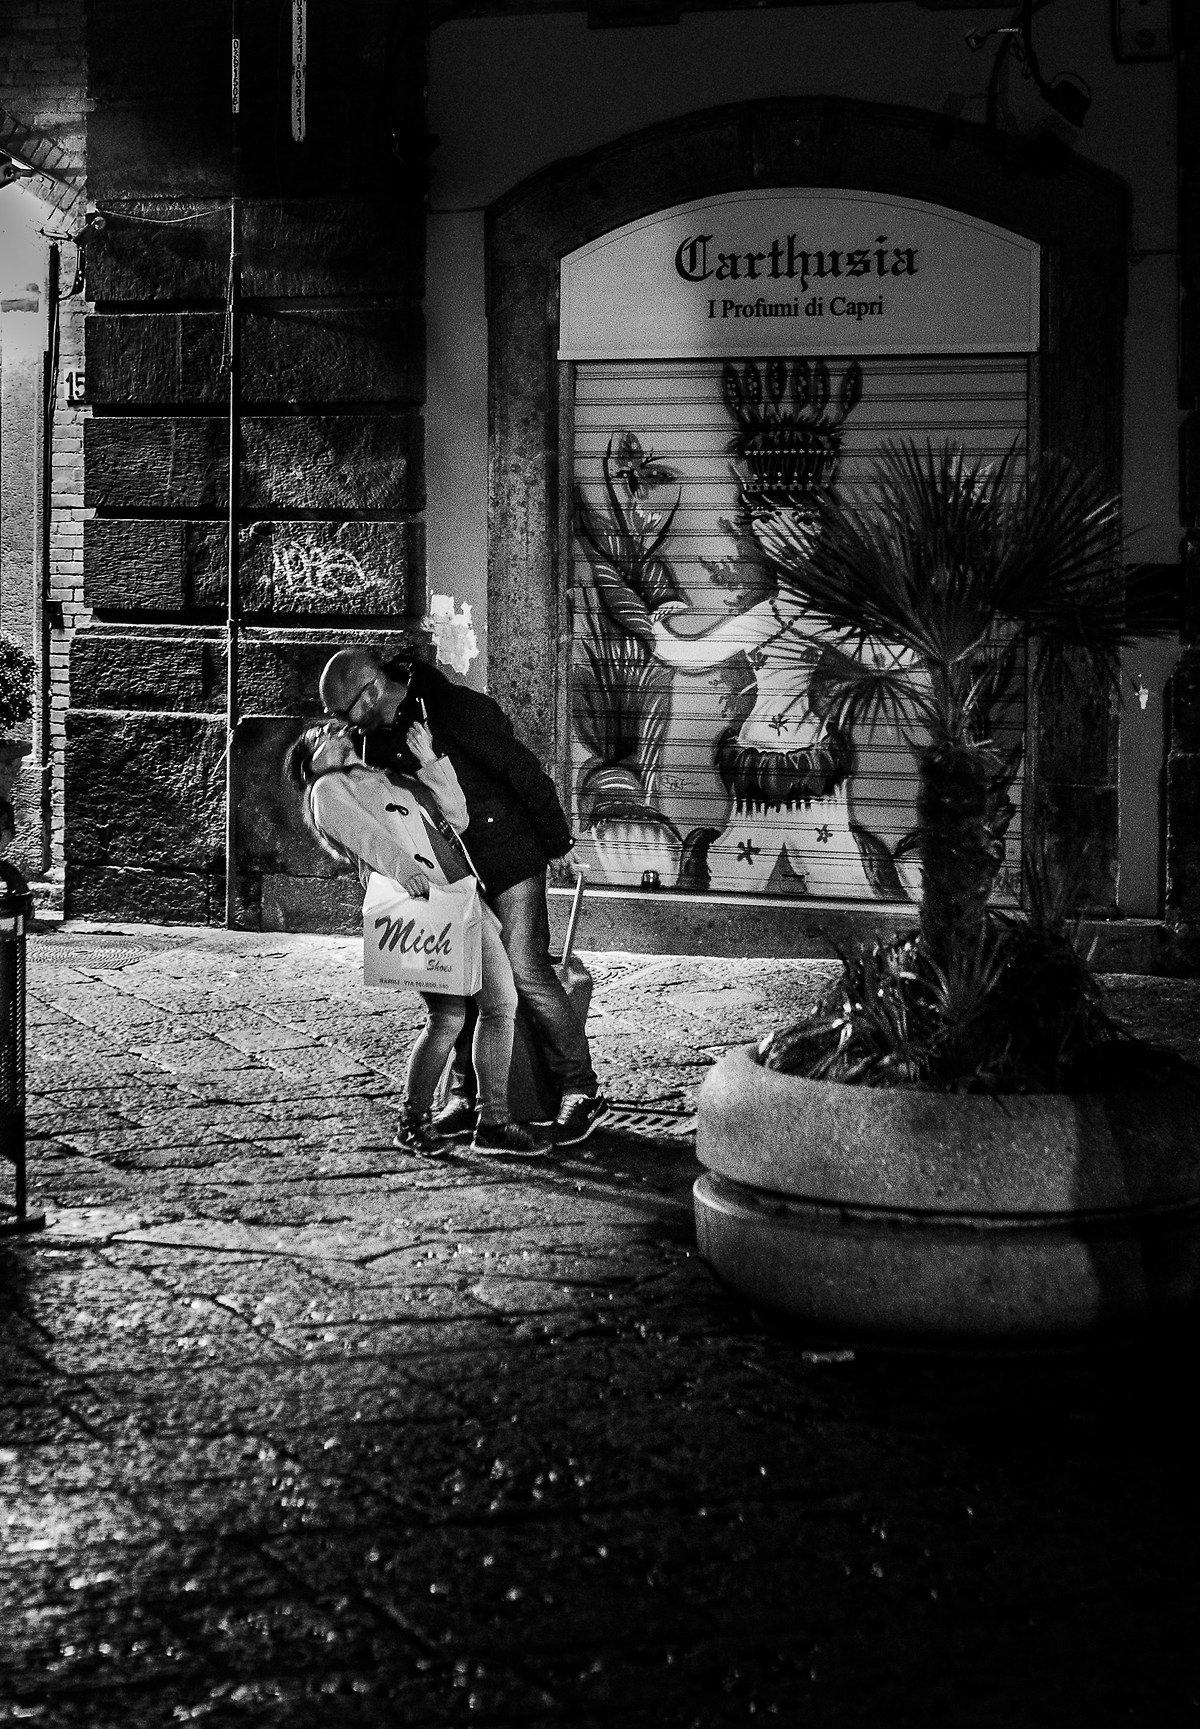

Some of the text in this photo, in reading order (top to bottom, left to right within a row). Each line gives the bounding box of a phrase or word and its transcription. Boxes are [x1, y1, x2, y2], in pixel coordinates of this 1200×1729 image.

[675, 234, 919, 292] Carthusia
[708, 296, 884, 321] I Profumi di Capri
[374, 915, 452, 955] Mich
[426, 959, 452, 973] Shoes
